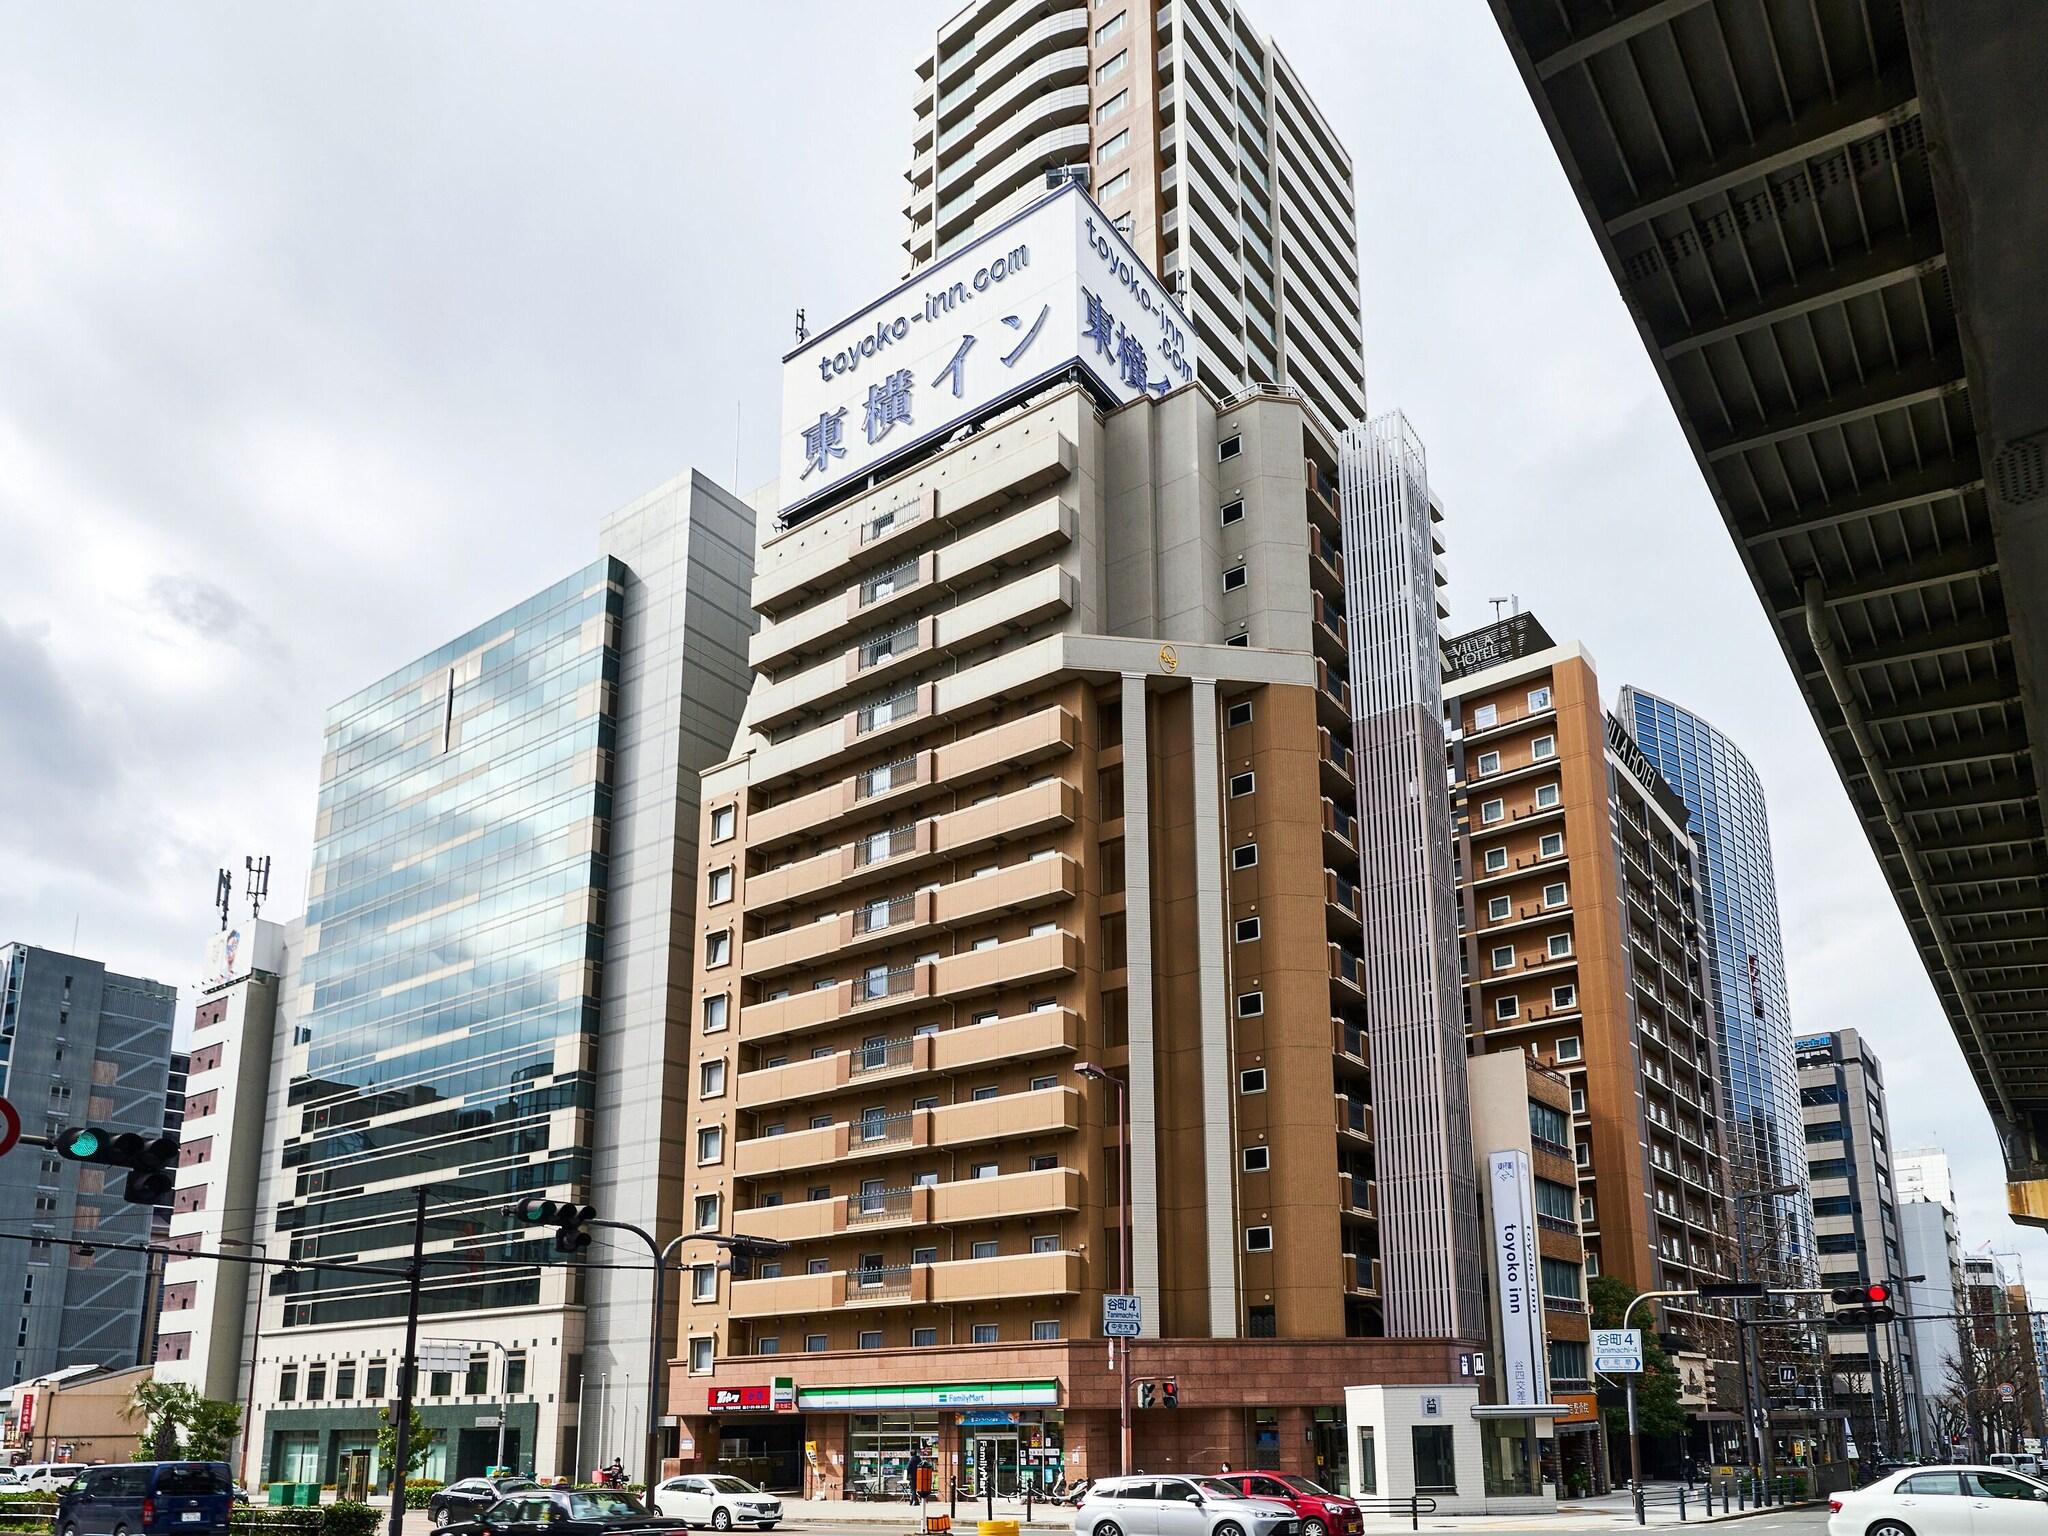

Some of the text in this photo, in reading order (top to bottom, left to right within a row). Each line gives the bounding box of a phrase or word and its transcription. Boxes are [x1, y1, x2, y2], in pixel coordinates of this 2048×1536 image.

[818, 244, 1030, 382] toyoko-inn.com
[1084, 216, 1185, 354] toyoko-inn
[800, 303, 1050, 481] 東横イン
[1452, 635, 1495, 656] VILLA
[1454, 644, 1500, 669] HOTEL
[1608, 716, 1657, 795] ILLA HOTEL
[1503, 1223, 1522, 1314] toyoko inn
[1107, 1311, 1139, 1319] Tanimachi-4
[1596, 1346, 1638, 1354] Tanimachi-4
[949, 1393, 984, 1403] FamilyMart
[978, 1440, 989, 1496] FamilyMart
